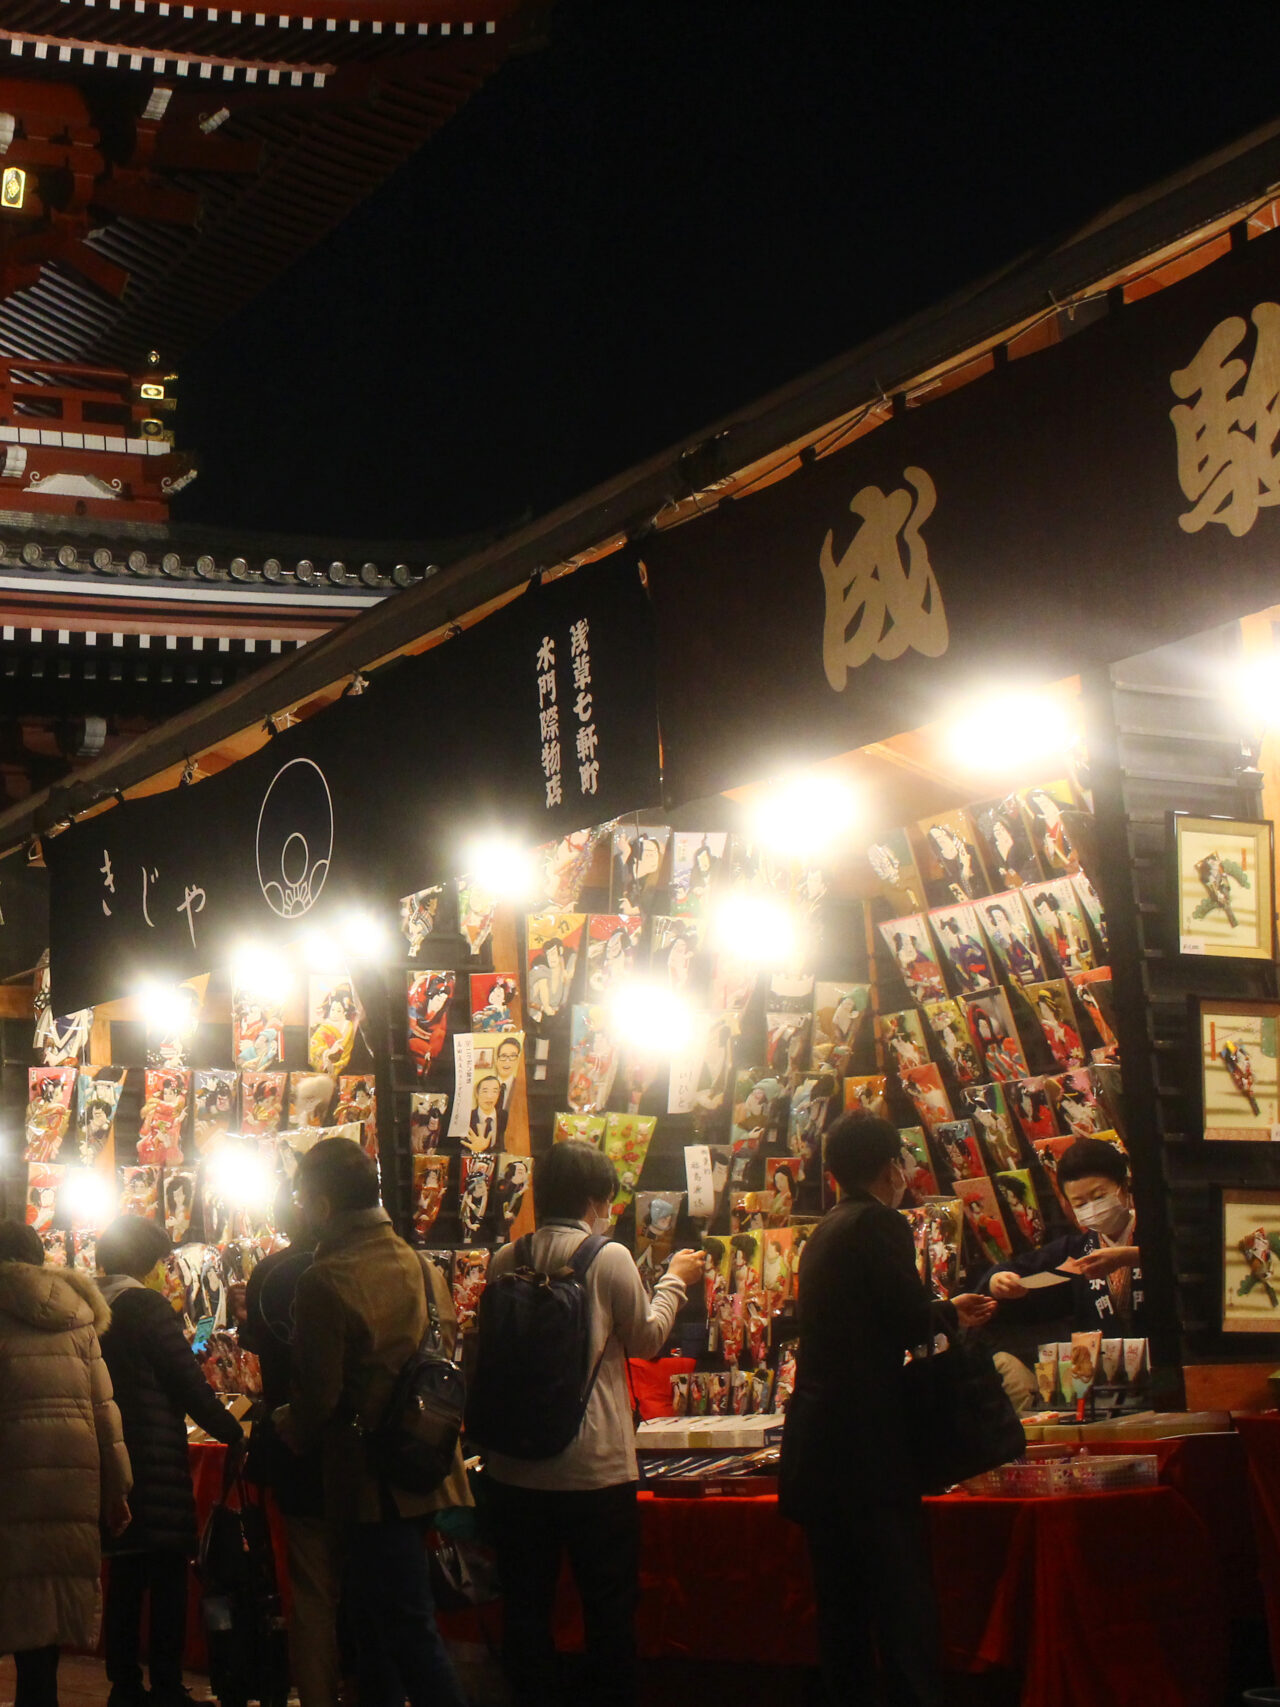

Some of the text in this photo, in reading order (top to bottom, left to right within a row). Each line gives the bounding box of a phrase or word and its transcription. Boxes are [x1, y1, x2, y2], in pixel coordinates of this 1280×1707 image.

[536, 636, 563, 809] 水門際物店
[570, 618, 600, 795] 浅草七軒町
[100, 849, 206, 948] きじや
